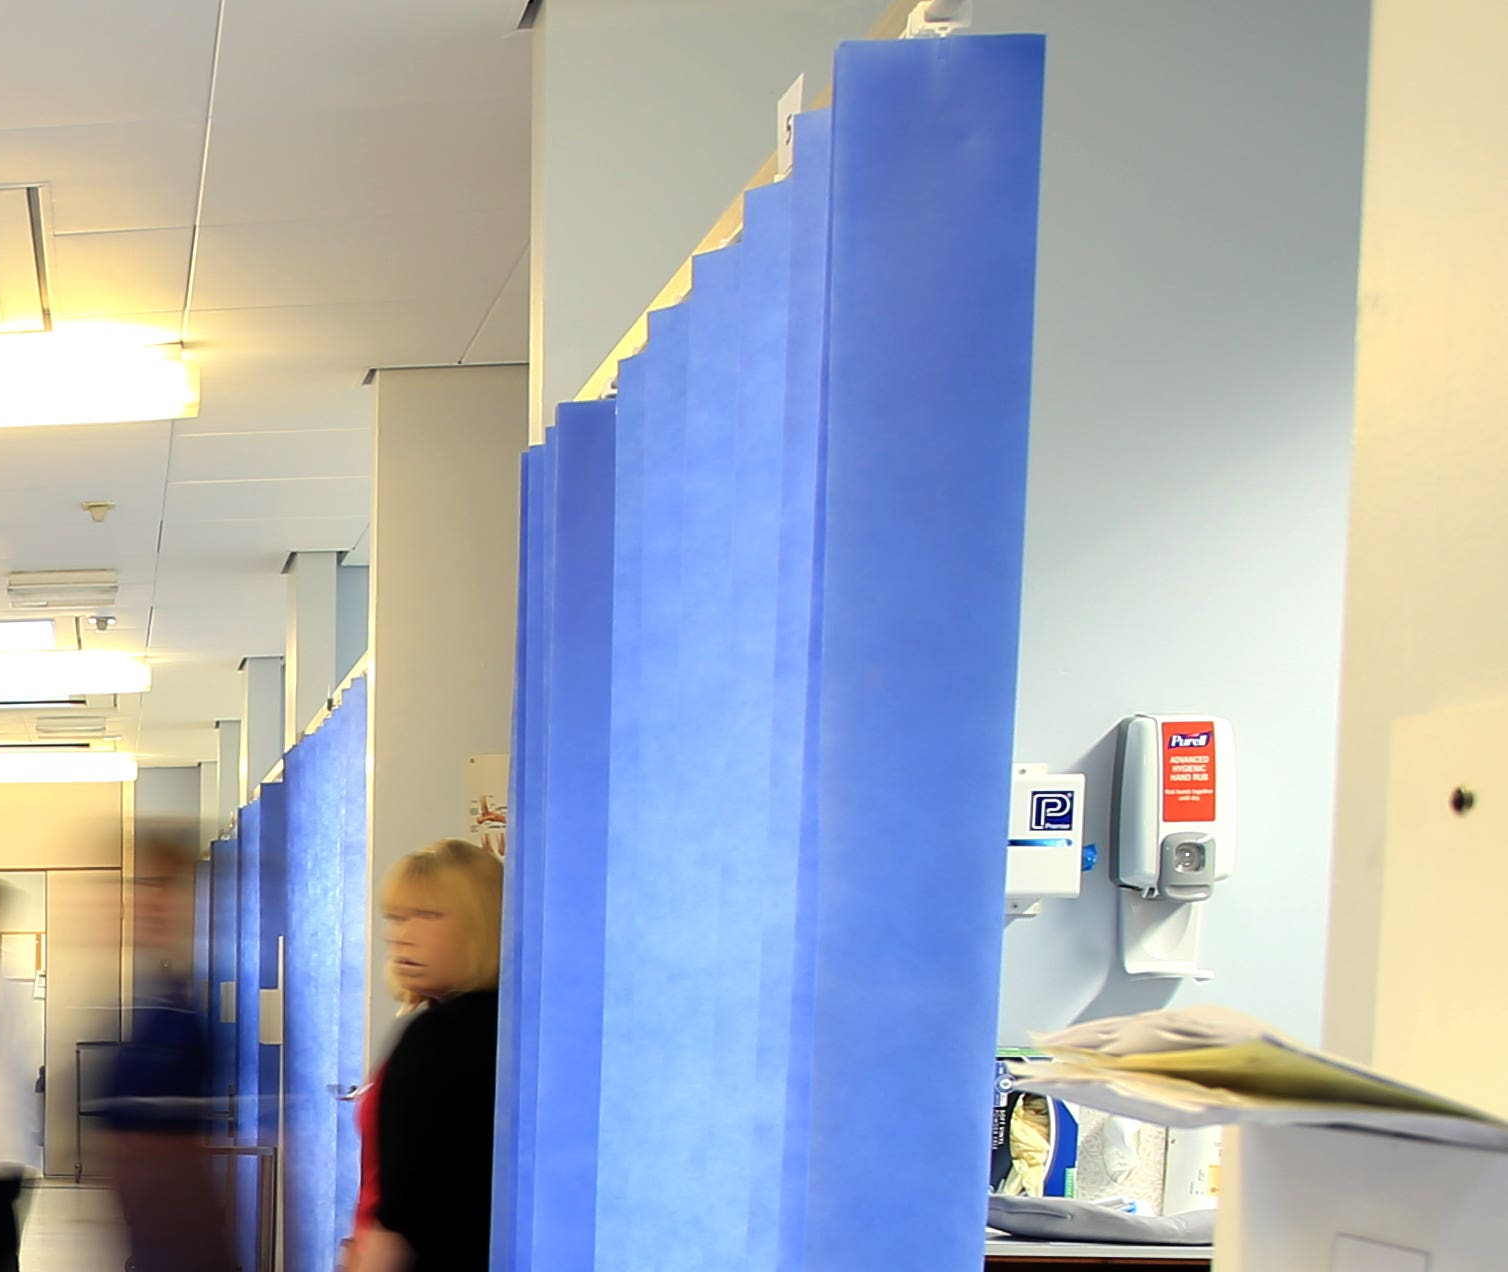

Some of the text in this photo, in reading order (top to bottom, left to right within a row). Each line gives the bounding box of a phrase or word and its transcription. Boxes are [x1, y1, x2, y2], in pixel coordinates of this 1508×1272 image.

[1171, 734, 1207, 747] Purell
[1169, 755, 1209, 763] ADVANCED
[1171, 764, 1207, 772] HYGIENIC
[1169, 773, 1209, 781] HAND RUB
